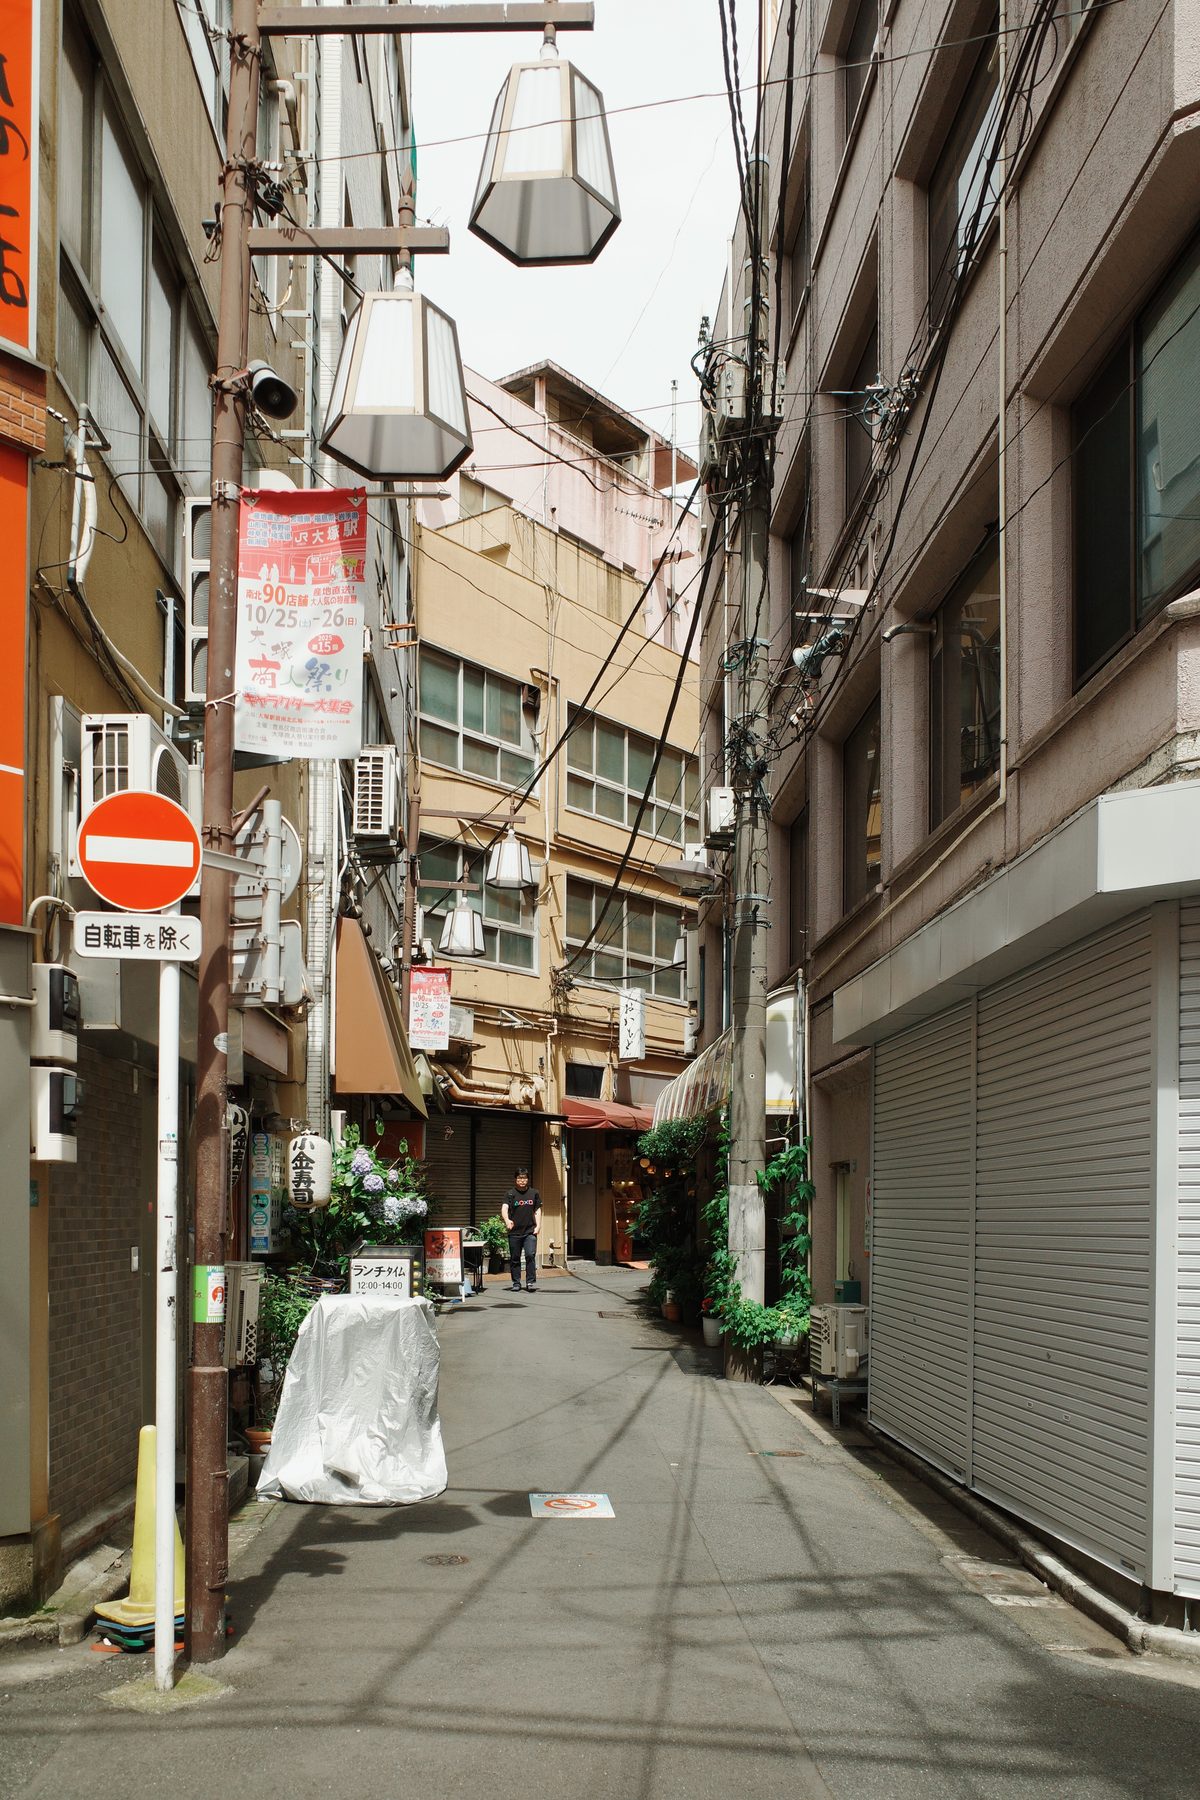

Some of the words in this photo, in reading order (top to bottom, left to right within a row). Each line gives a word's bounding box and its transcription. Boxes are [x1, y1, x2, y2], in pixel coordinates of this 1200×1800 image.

[84, 923, 190, 950] 自転車を除く
[291, 1137, 316, 1204] 小金寿司
[353, 1264, 406, 1278] ランチタイム
[357, 1281, 403, 1290] 12:00-14:00
